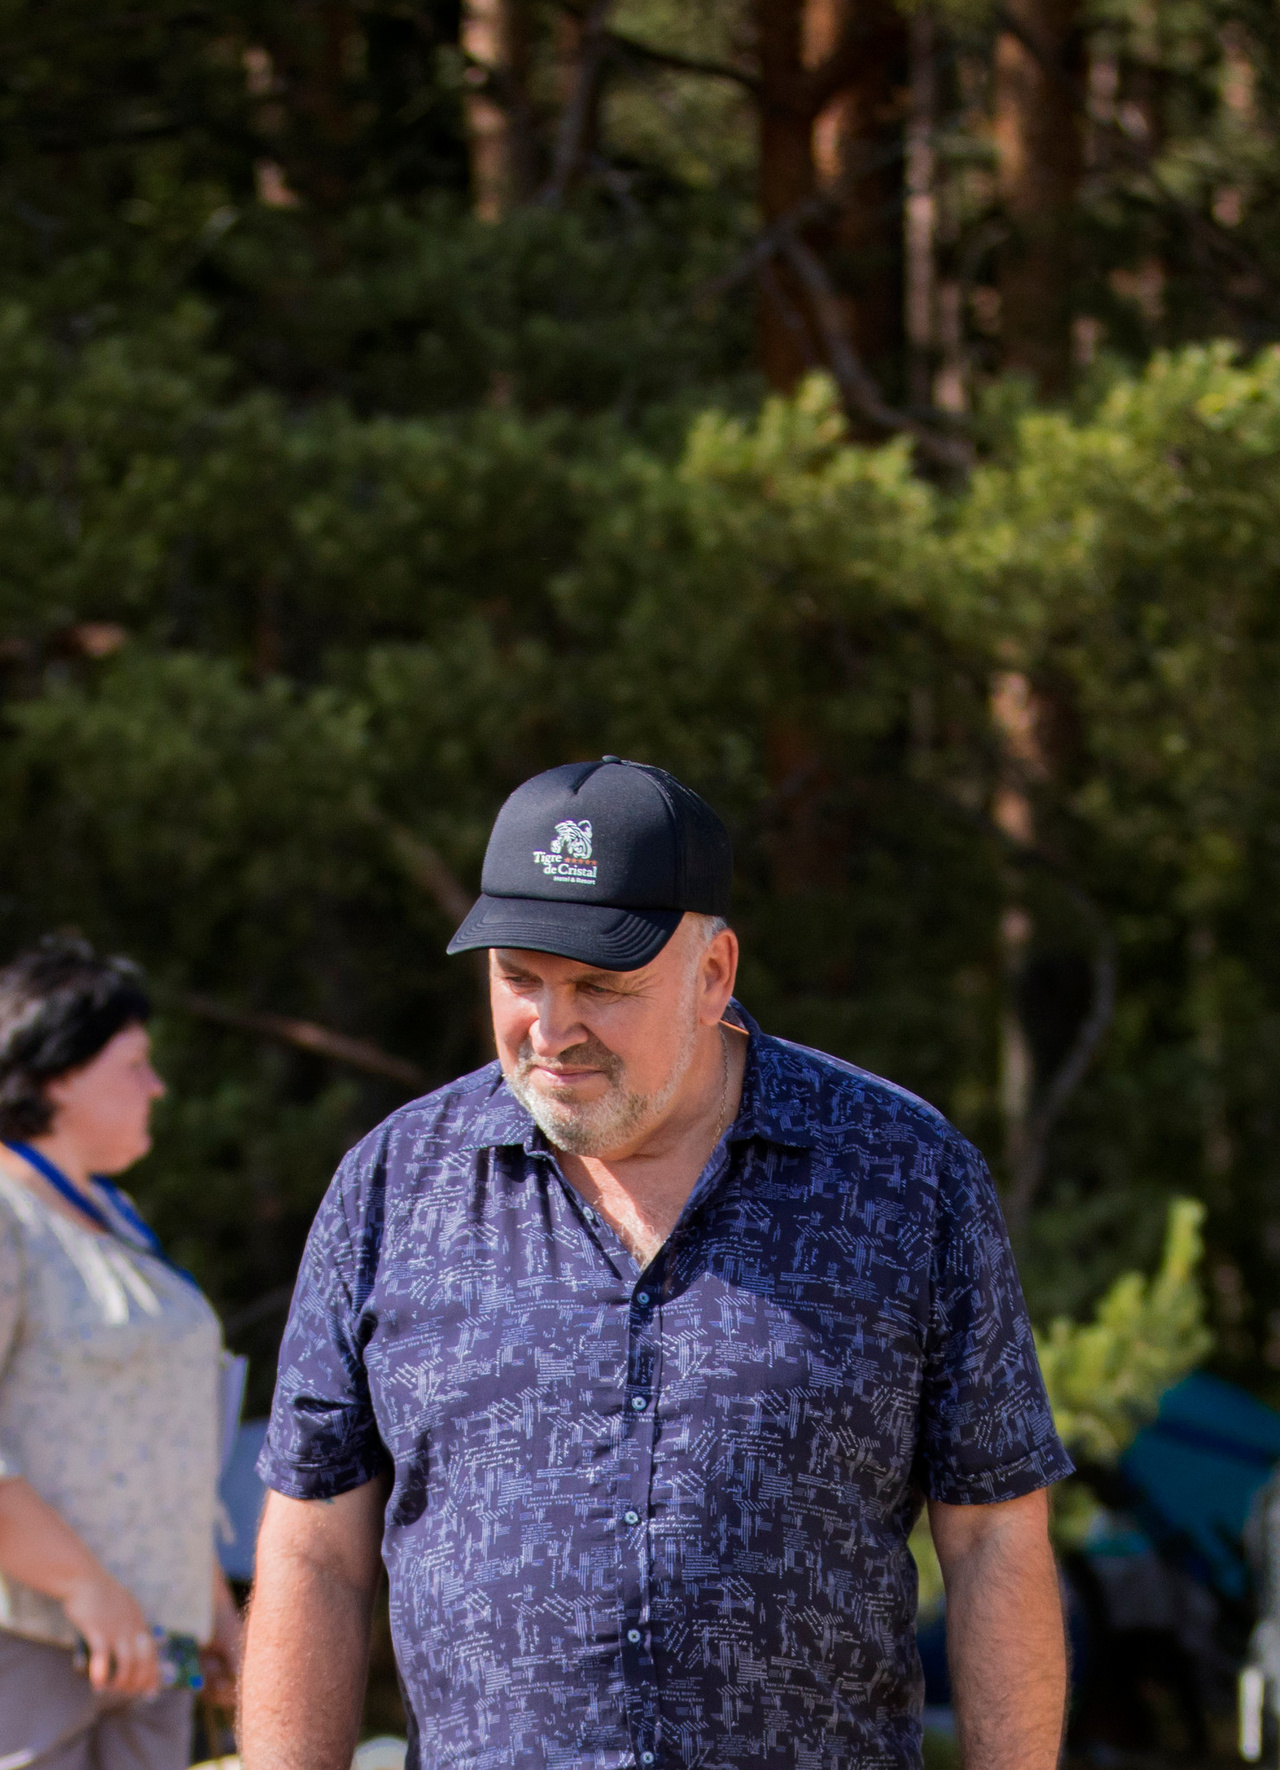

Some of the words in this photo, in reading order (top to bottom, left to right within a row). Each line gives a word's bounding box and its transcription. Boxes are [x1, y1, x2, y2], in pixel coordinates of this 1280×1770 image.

[533, 851, 563, 866] Tigre
[543, 863, 557, 875] de
[558, 863, 597, 878] Cristal
